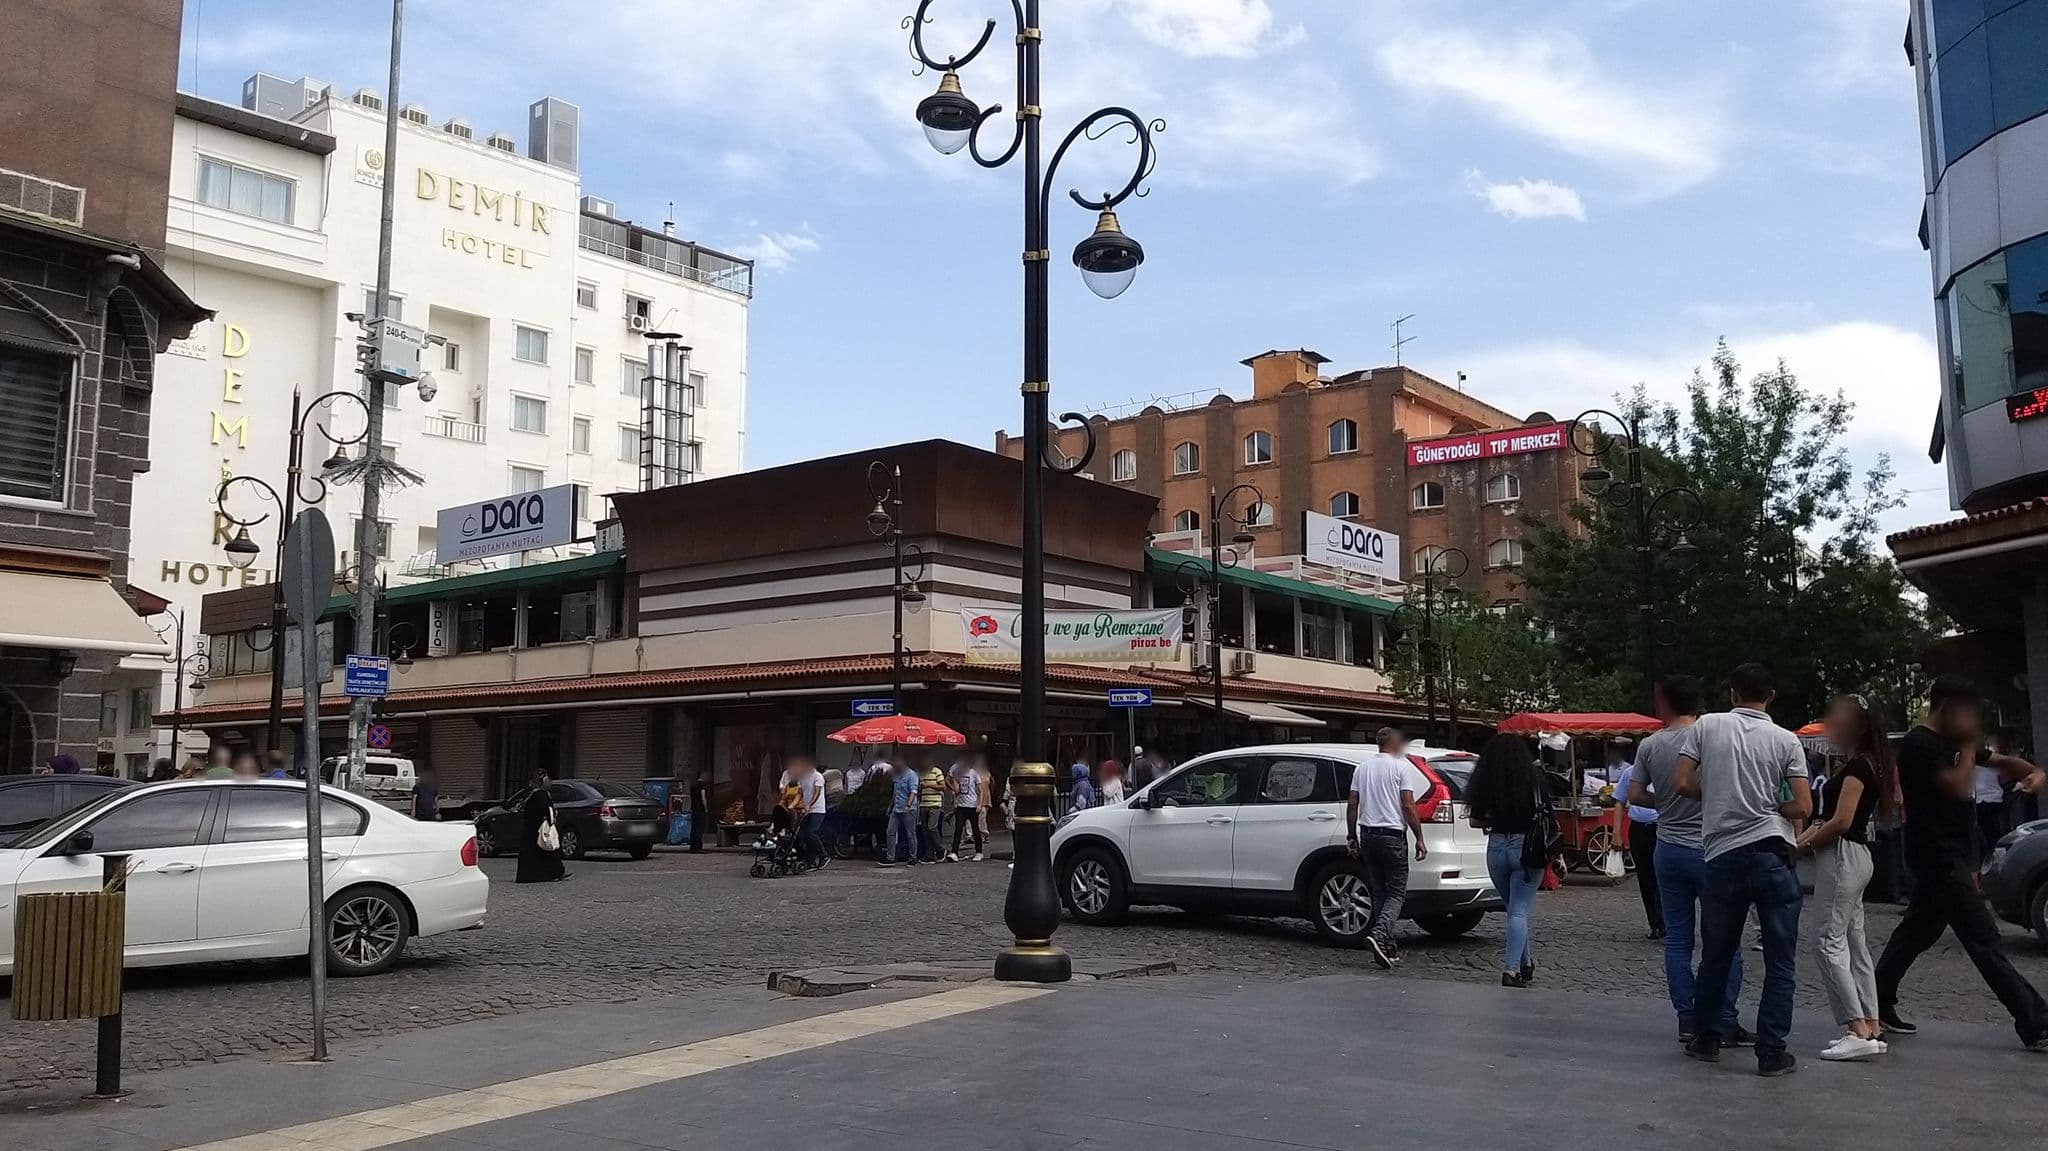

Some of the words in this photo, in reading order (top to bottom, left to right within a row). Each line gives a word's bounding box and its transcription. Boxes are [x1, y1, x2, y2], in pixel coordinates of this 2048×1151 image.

[417, 167, 550, 234] DEMİR
[442, 228, 533, 269] HOTEL
[1416, 441, 1481, 463] GÜNEYDOĞU
[1490, 440, 1508, 454] TIP
[1511, 430, 1561, 451] MERKEZİ
[1053, 622, 1070, 635] we
[1072, 622, 1090, 641] ya
[1093, 613, 1166, 638] Remezanê
[1131, 638, 1157, 650] piroz
[1159, 638, 1171, 648] be
